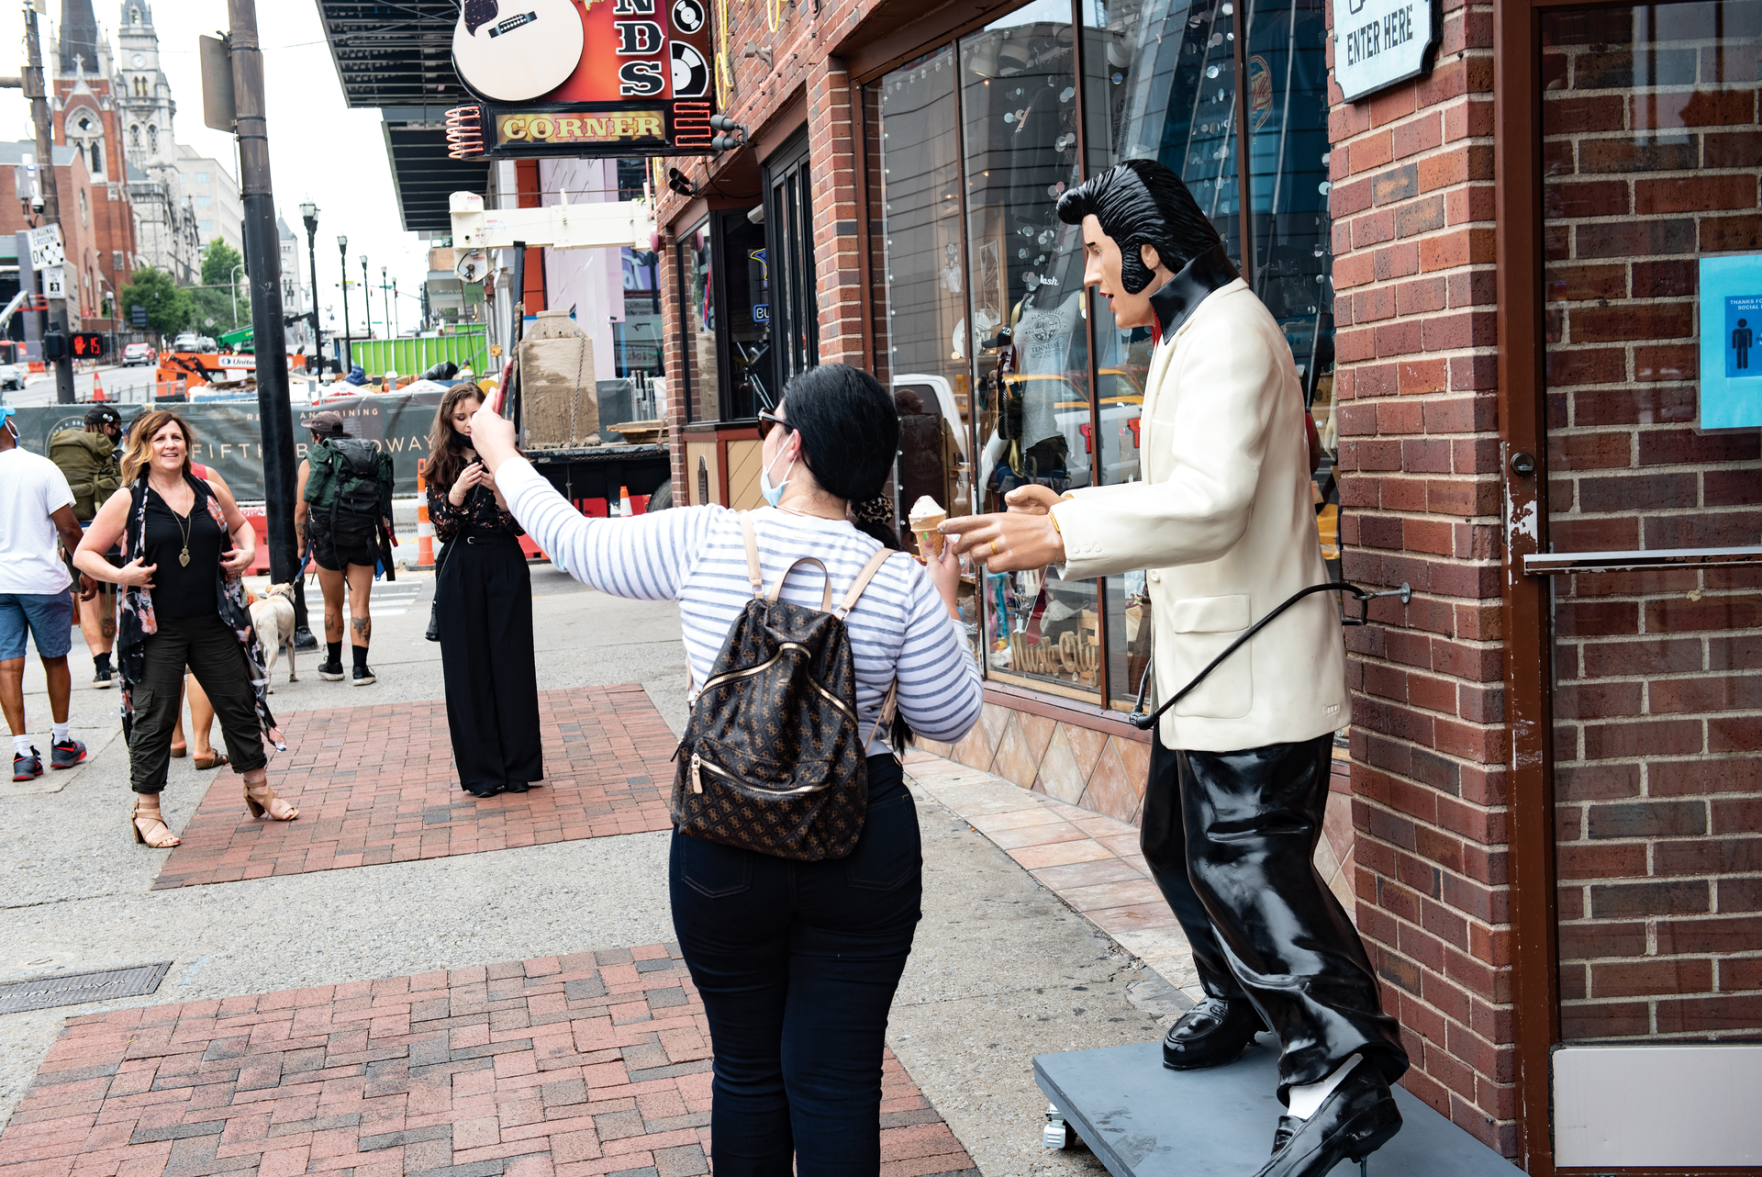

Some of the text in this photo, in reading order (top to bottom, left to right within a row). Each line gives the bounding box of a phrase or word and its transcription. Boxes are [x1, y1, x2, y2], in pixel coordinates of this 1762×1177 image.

[1347, 3, 1413, 67] ENTER HERE
[502, 116, 663, 139] CORNER
[32, 248, 47, 265] OK
[300, 410, 324, 420] AN
